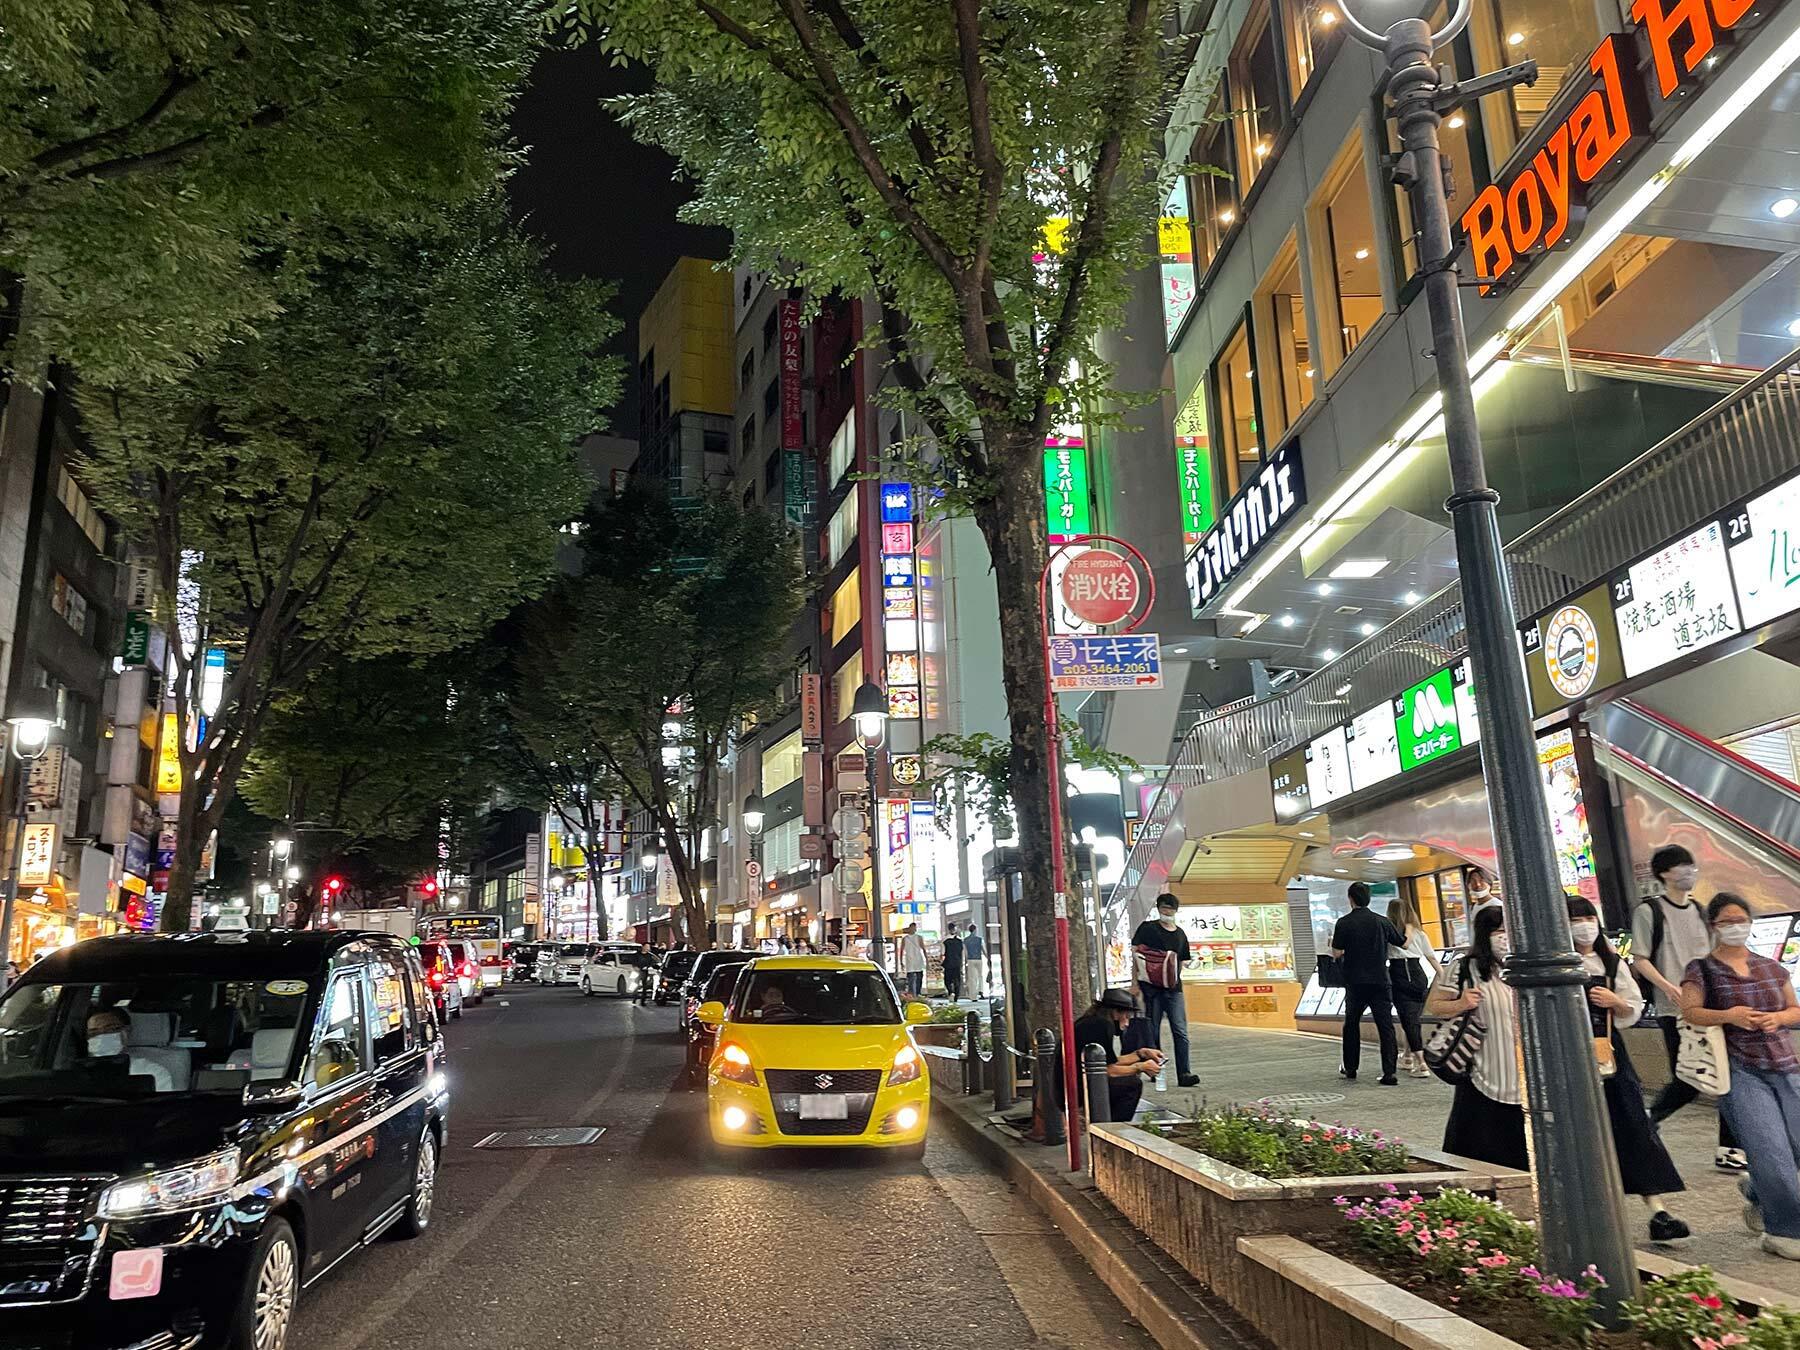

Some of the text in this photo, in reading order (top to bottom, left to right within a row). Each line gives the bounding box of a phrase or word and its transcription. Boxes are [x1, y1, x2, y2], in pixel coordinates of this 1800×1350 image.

[1462, 36, 1631, 297] Royal
[784, 303, 798, 371] たかの友梨
[1056, 450, 1075, 530] モスバーガー
[1185, 450, 1295, 609] サンマルクカフェ
[1729, 514, 1748, 539] 2F
[1073, 560, 1123, 568] FIRE HYDRANT
[1068, 573, 1132, 601] 消火栓
[1615, 578, 1631, 601] 2F
[1623, 581, 1696, 637] 焼売酒場
[1525, 628, 1538, 647] 2F
[1674, 603, 1734, 650] 道玄坂
[1056, 677, 1077, 687] 買取
[1073, 663, 1150, 674] 03-3464-2061
[1454, 666, 1465, 681] 1F
[1413, 733, 1453, 760] モスバーガー
[40, 828, 50, 863] ステーキ
[1191, 915, 1236, 931] ねぎし
